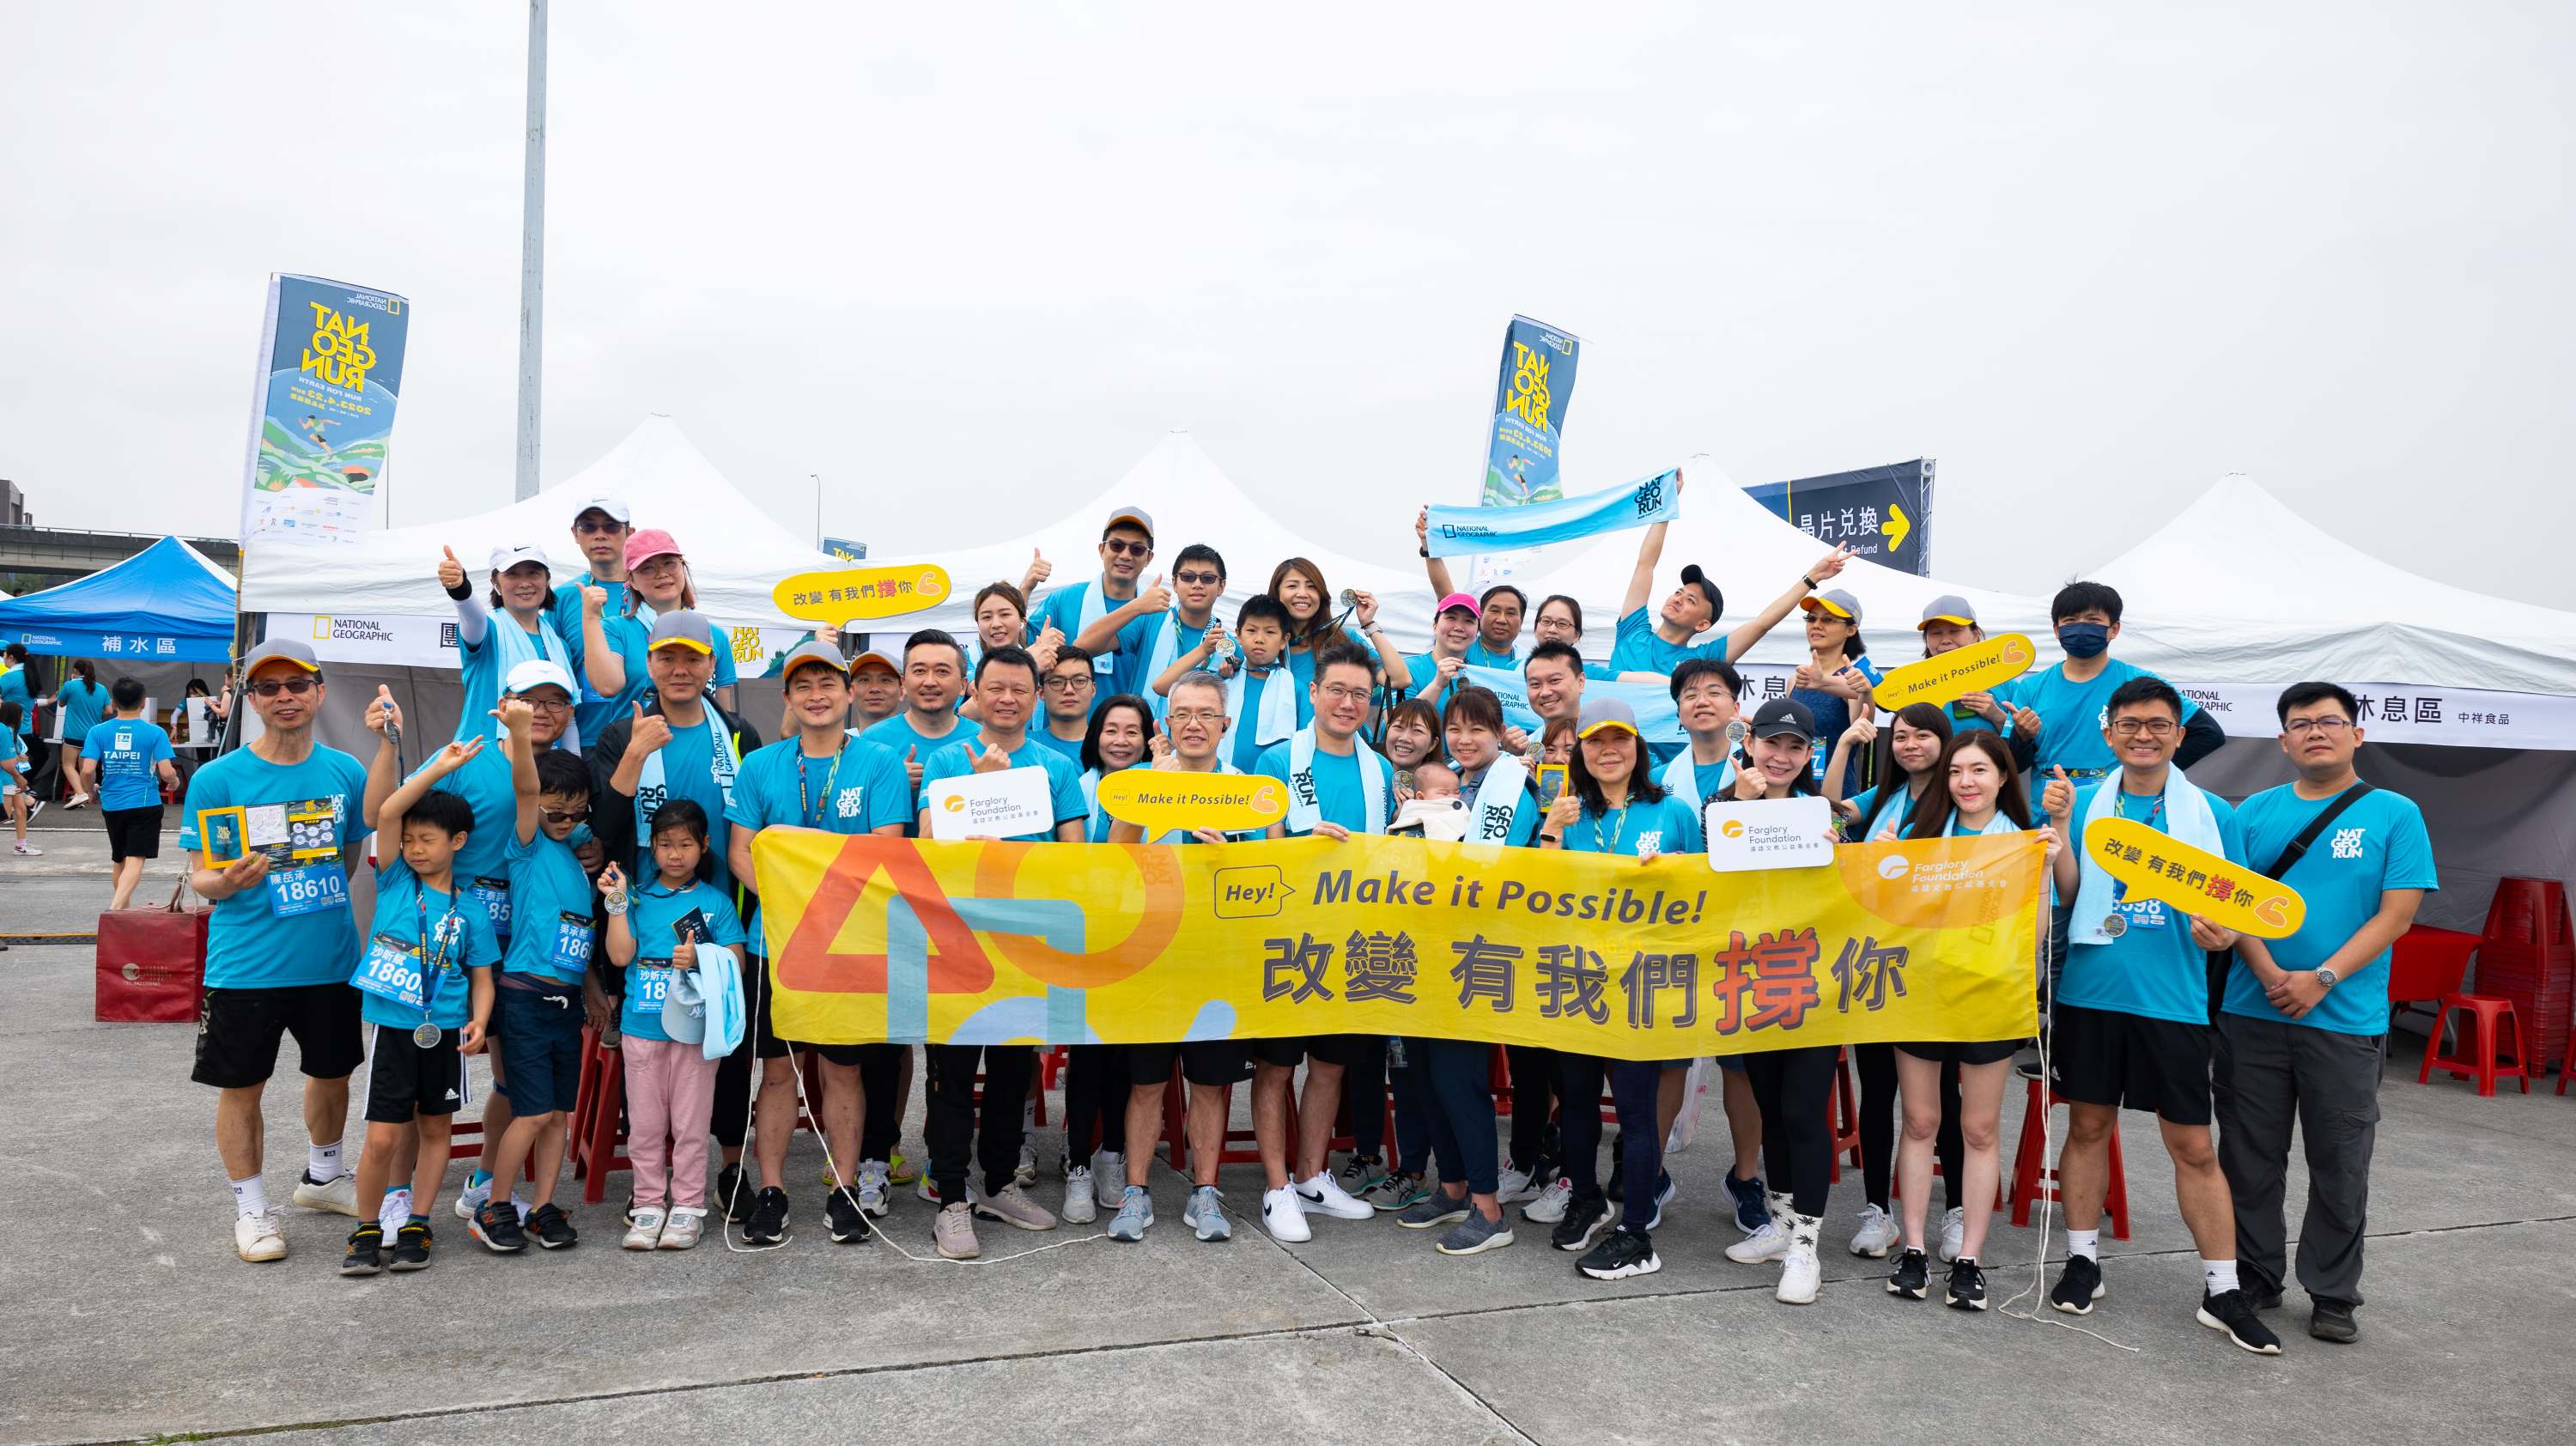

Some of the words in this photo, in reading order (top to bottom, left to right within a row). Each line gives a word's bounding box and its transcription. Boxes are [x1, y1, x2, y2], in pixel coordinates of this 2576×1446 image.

[1639, 475, 1664, 495] NAT
[1634, 486, 1661, 503] GEO
[1638, 495, 1662, 514] RUN
[793, 591, 823, 606] 改變
[334, 619, 380, 631] NATIONAL
[332, 629, 393, 642] GEOGRAPHIC
[733, 626, 760, 639] NAT
[102, 635, 176, 654] 補水區
[730, 635, 760, 651] GEO
[733, 647, 763, 664] RUN
[1908, 679, 1938, 694] Make
[1940, 673, 1948, 683] it
[1951, 654, 2000, 678] Possible!
[1494, 691, 1521, 702] ATIONAL
[2181, 690, 2221, 701] ATIONAL
[1499, 699, 1528, 710] GRAPHIC
[2458, 712, 2510, 726] 中祥食品
[104, 750, 140, 759] TAIPEI
[841, 787, 864, 799] NAT
[1292, 772, 1318, 806] RUN
[836, 797, 860, 809] GEO
[969, 797, 1008, 807] Farglory
[1138, 793, 1173, 805] Make
[1176, 794, 1187, 805] it
[1190, 793, 1250, 805] Possible!
[839, 806, 861, 817] RUN
[971, 805, 1021, 817] Foundation
[1483, 805, 1499, 840] RUN
[1492, 805, 1514, 839] GEO
[1640, 831, 1662, 841] NAT
[1748, 826, 1788, 835] Farglory
[2336, 829, 2366, 838] NAT
[1635, 840, 1660, 850] GEO
[1749, 835, 1801, 844] Foundation
[2330, 838, 2360, 848] GEO
[2333, 848, 2363, 859] RUN
[1915, 860, 1968, 872] Farglory
[2104, 837, 2143, 866] 改變
[2148, 854, 2254, 908] 有我們撐你
[1912, 870, 1984, 884] Foundation
[276, 876, 340, 902] 18610
[1225, 883, 1275, 904] Hey!
[1313, 869, 1436, 906] Make
[1450, 875, 1484, 908] it
[1498, 880, 1707, 925] Possible!
[368, 959, 423, 993] 1860
[1262, 930, 1419, 1005] 改變
[1450, 927, 1910, 1036] 有我們撐你
